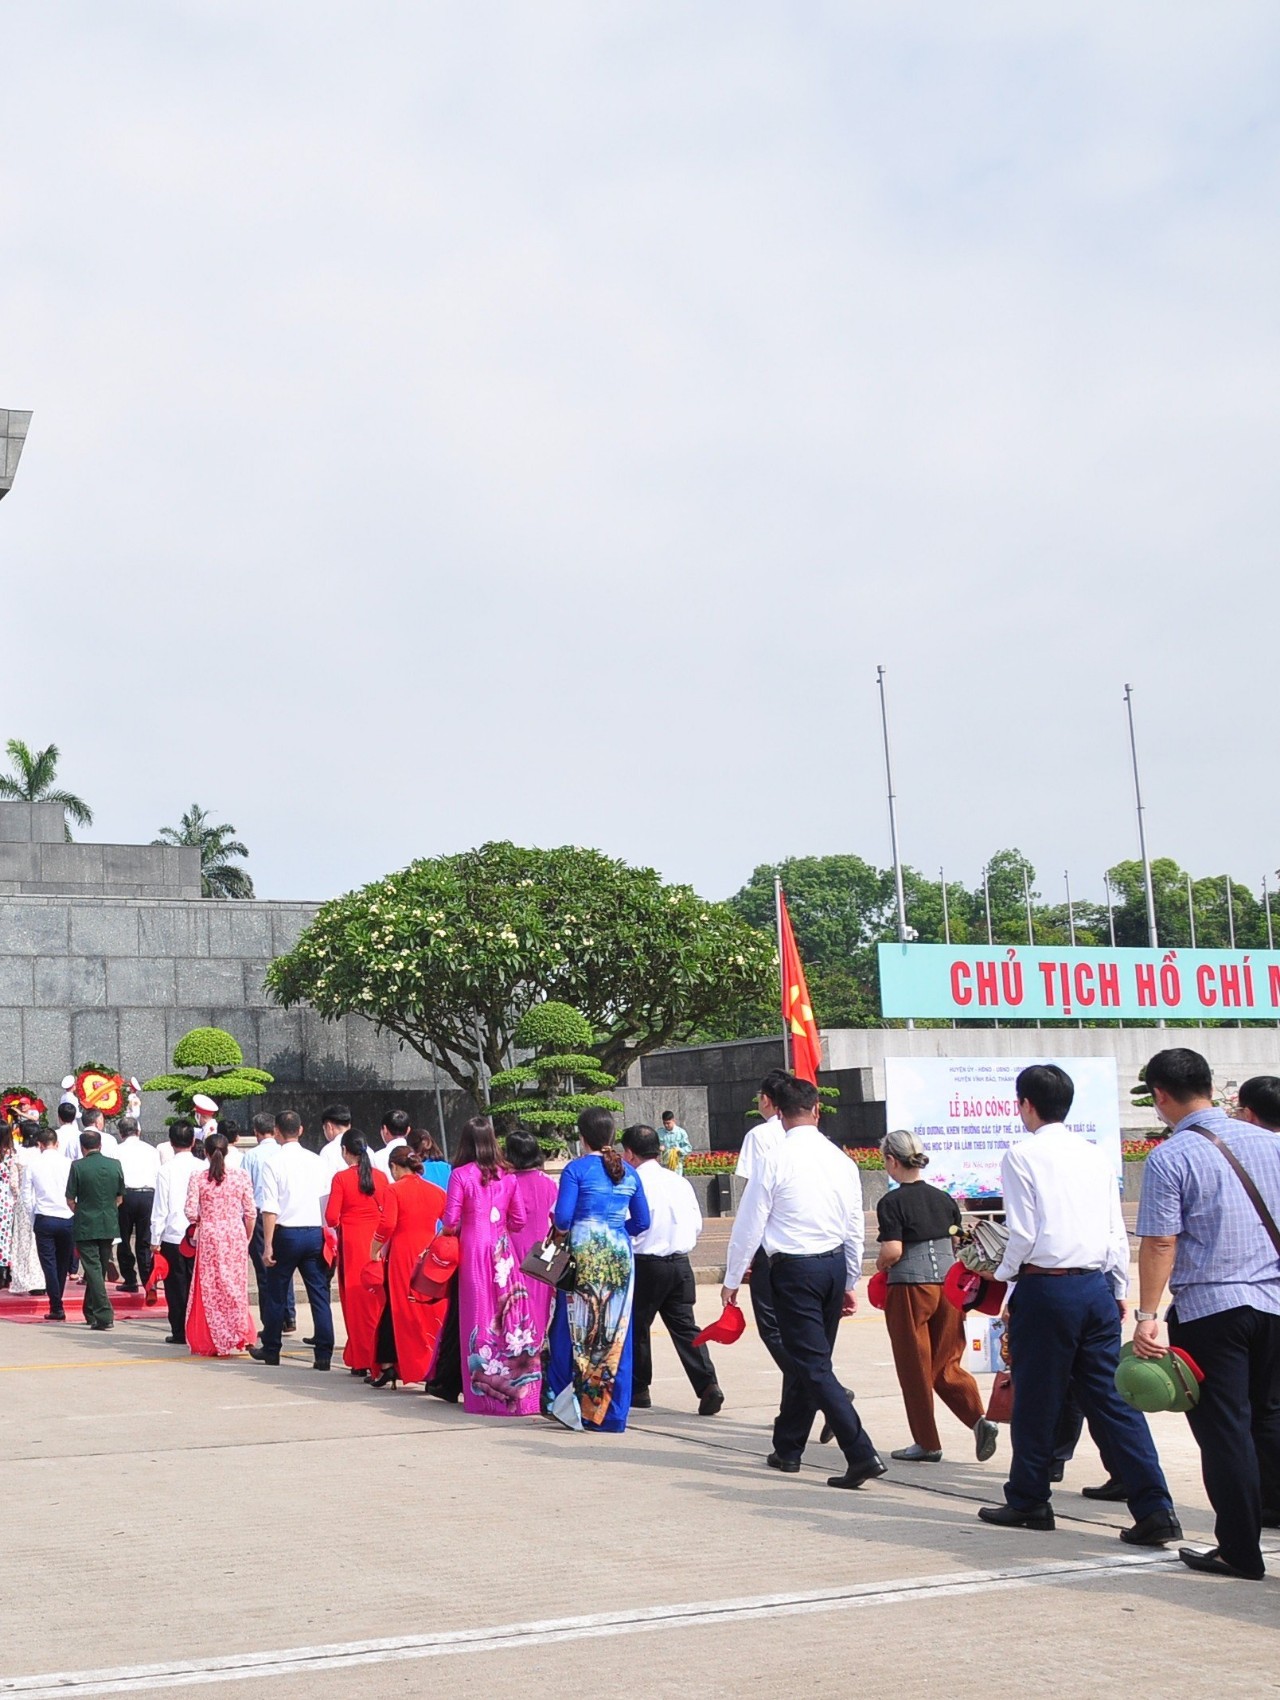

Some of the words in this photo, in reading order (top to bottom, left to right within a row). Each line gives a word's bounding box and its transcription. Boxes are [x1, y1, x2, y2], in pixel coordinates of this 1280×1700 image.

[950, 948, 1024, 1006] CHỦ
[1038, 962, 1121, 1015] TỊCH
[1135, 950, 1181, 1007] HỒ
[1196, 955, 1255, 1008] CHÍ
[985, 1095, 1011, 1117] CÔNG
